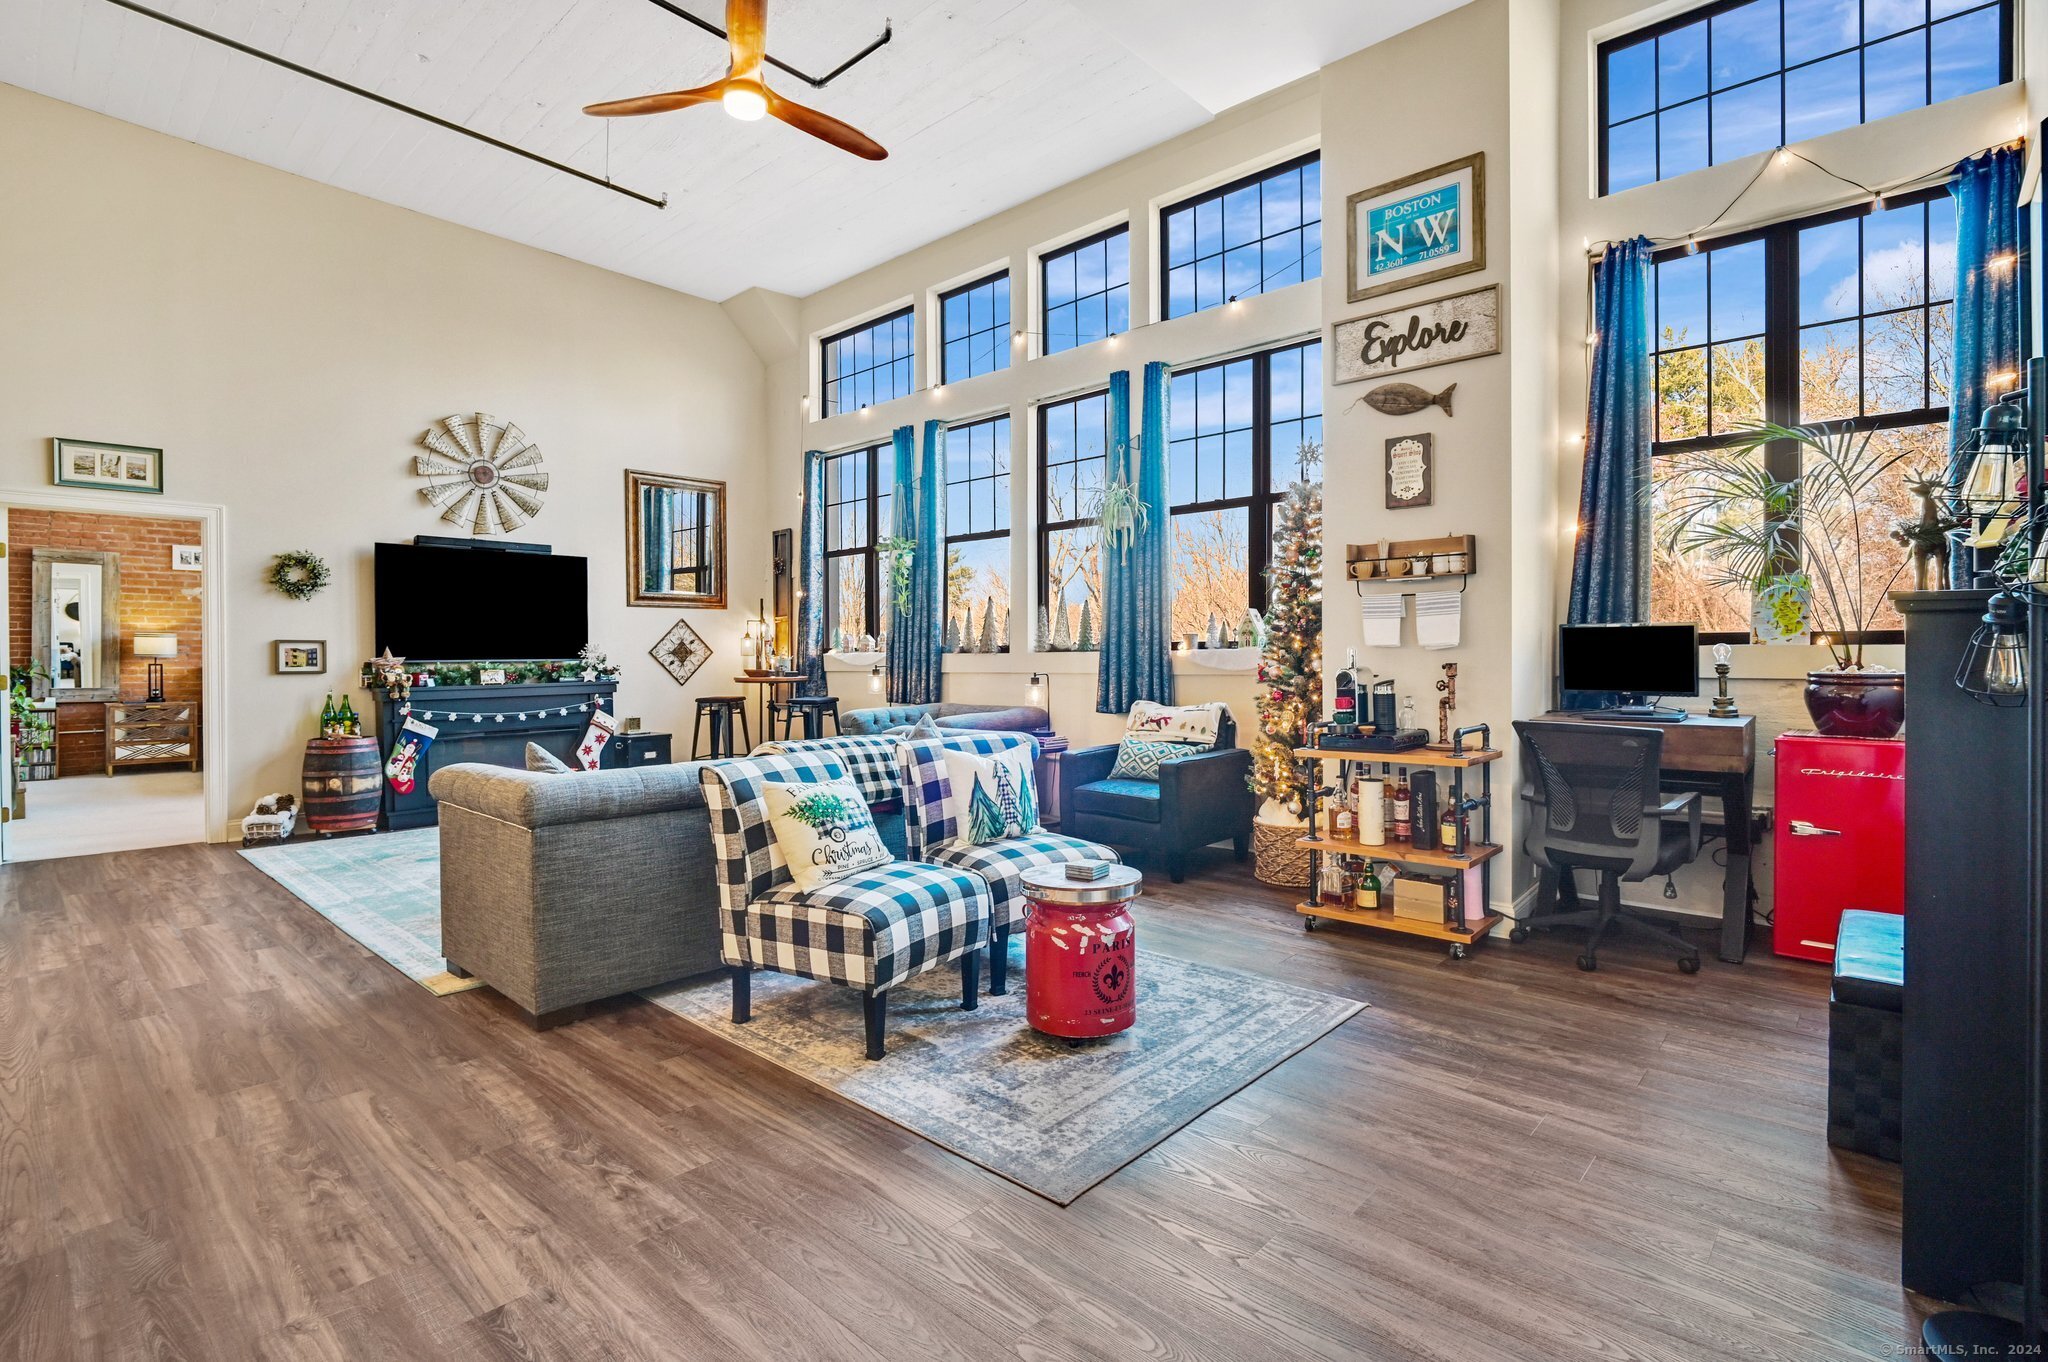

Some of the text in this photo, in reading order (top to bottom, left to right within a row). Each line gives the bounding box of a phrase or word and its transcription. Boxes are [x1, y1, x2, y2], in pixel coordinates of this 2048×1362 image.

[1385, 193, 1441, 220] BOSTON
[1375, 208, 1456, 262] N W
[1374, 243, 1454, 272] 42.3601° 71.0589°
[1360, 315, 1469, 368] Explore
[1800, 768, 1906, 780] Frigidaire
[812, 841, 872, 865] Christmas
[857, 856, 873, 866] SPRUCE
[1093, 937, 1131, 954] PARIS
